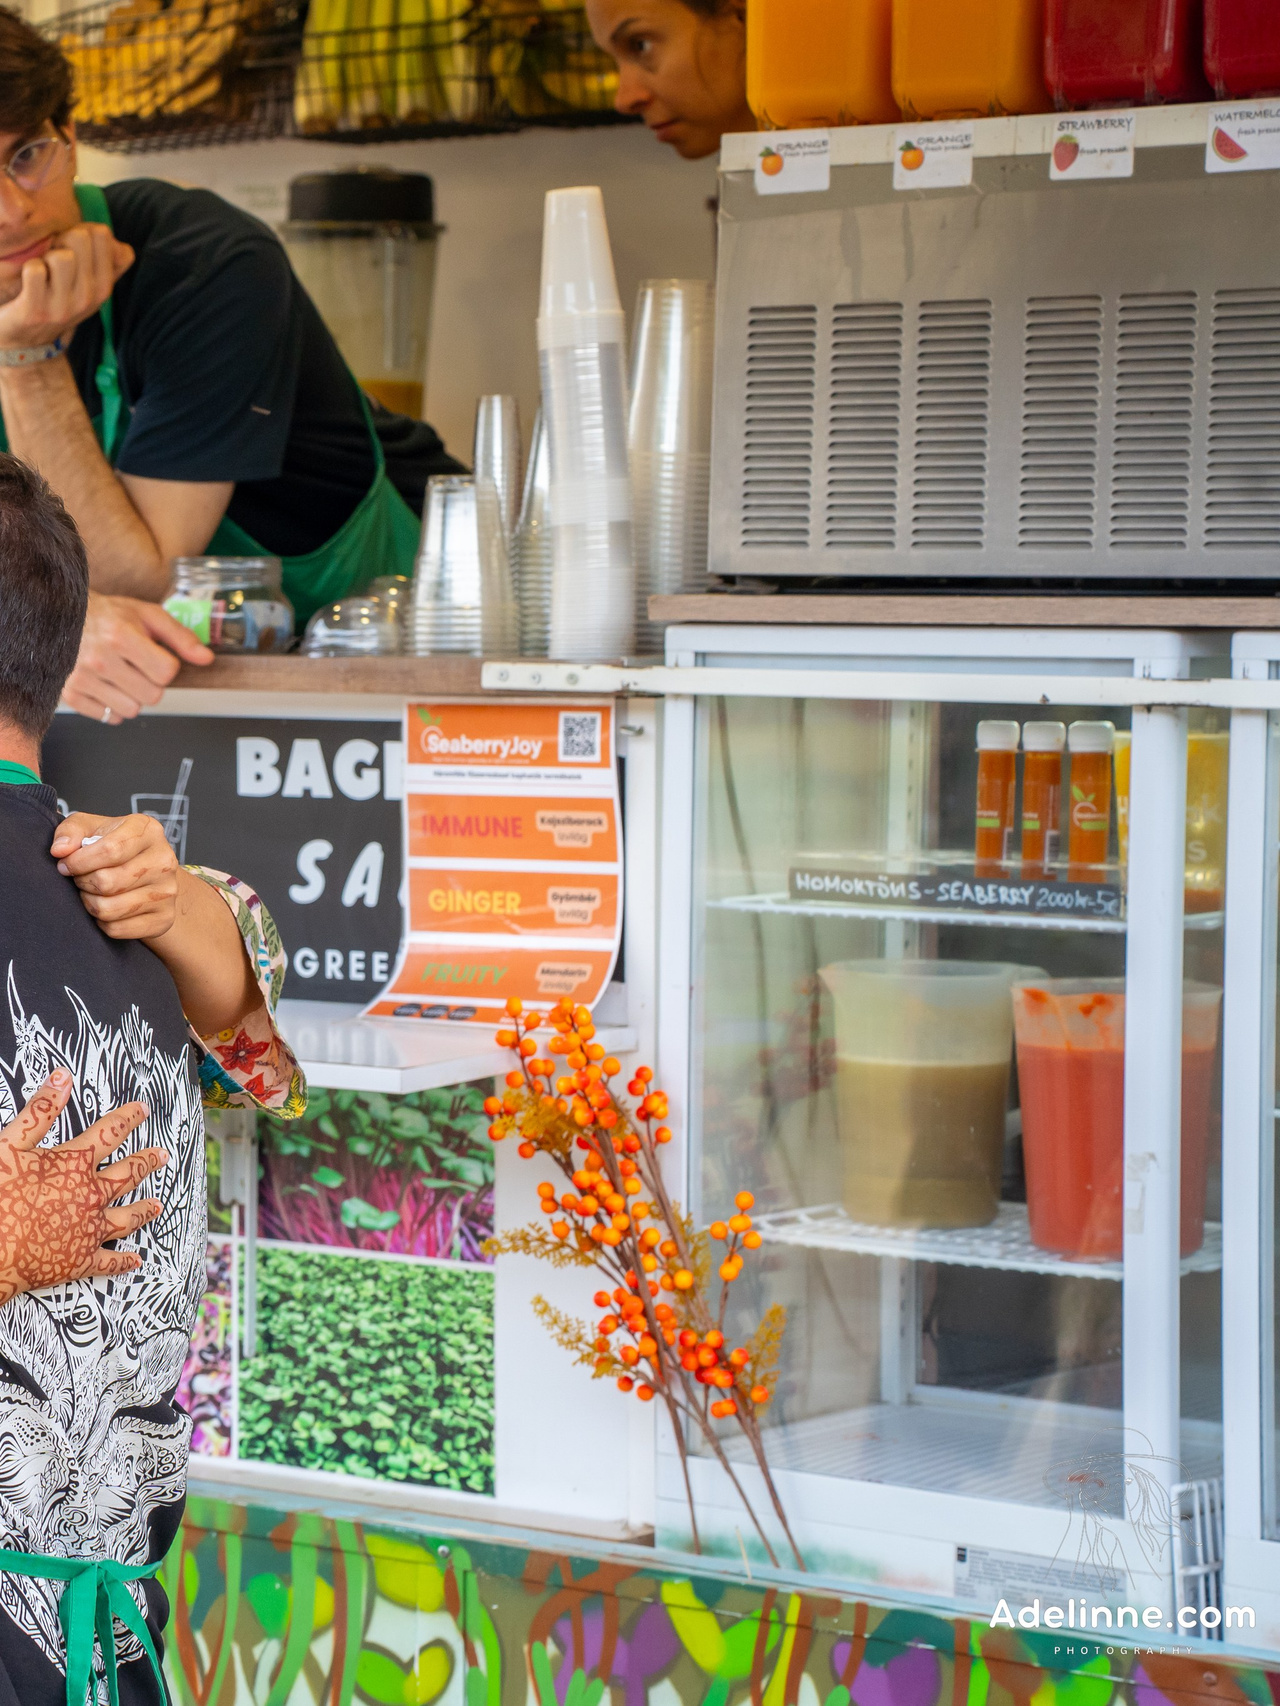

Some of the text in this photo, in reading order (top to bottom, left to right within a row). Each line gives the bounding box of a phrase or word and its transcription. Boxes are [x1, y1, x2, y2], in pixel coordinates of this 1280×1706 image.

[1057, 117, 1133, 132] STRAWBERRY
[421, 814, 523, 839] IMMUNE
[428, 888, 521, 915] GINGER
[937, 880, 1034, 906] SEABERRY
[421, 963, 508, 985] FRUITY
